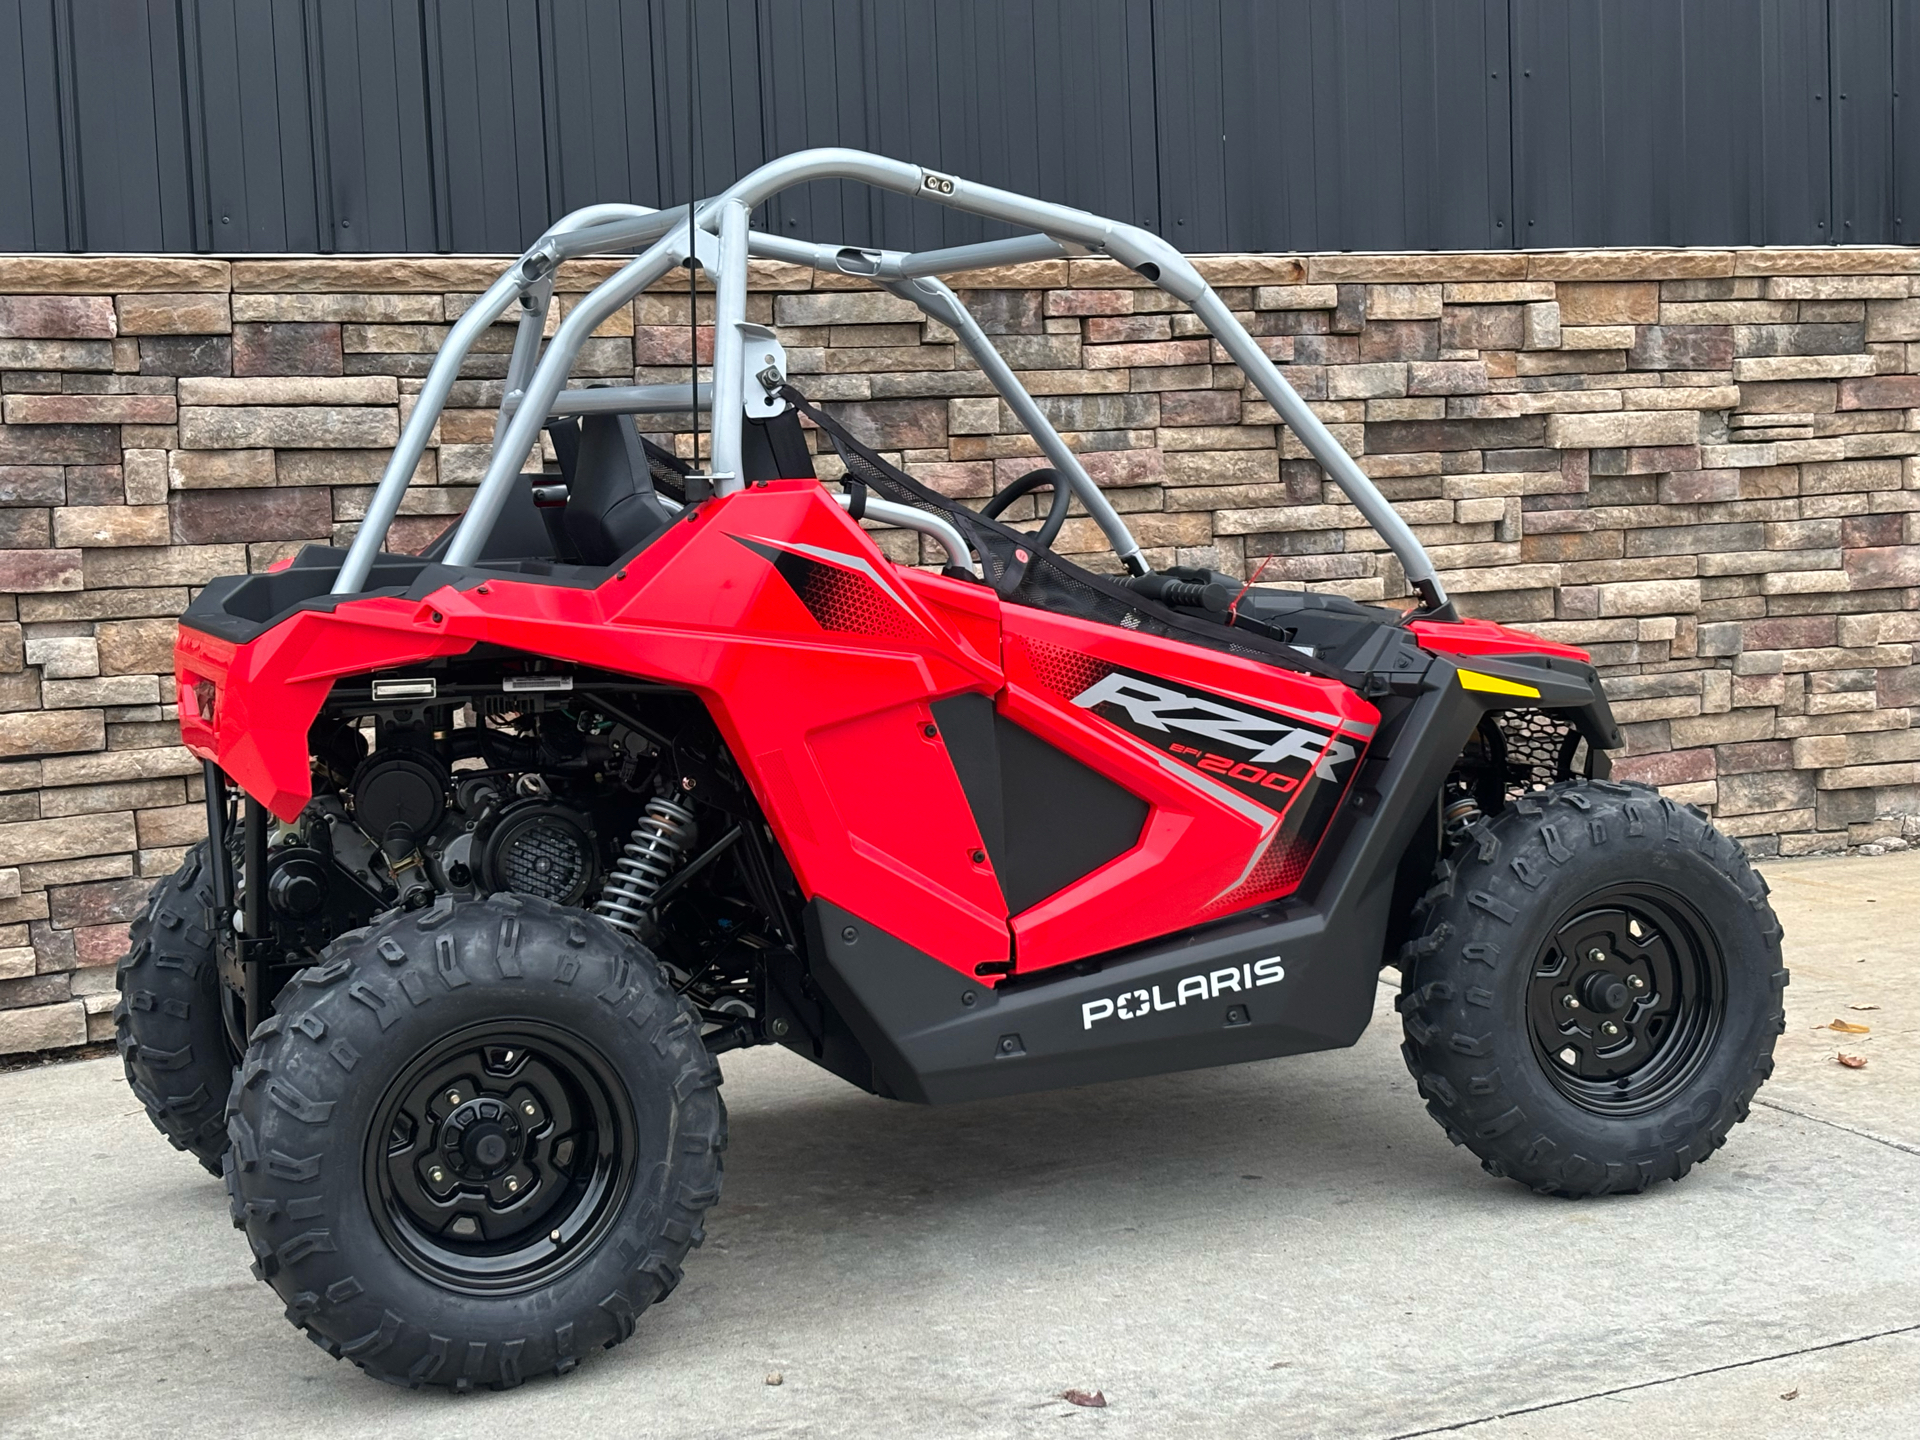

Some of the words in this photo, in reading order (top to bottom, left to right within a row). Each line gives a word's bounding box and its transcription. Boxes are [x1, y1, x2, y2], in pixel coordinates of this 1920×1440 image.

[1069, 672, 1355, 783] RZR
[1197, 753, 1299, 793] 200
[1081, 956, 1285, 1030] POLARIS
